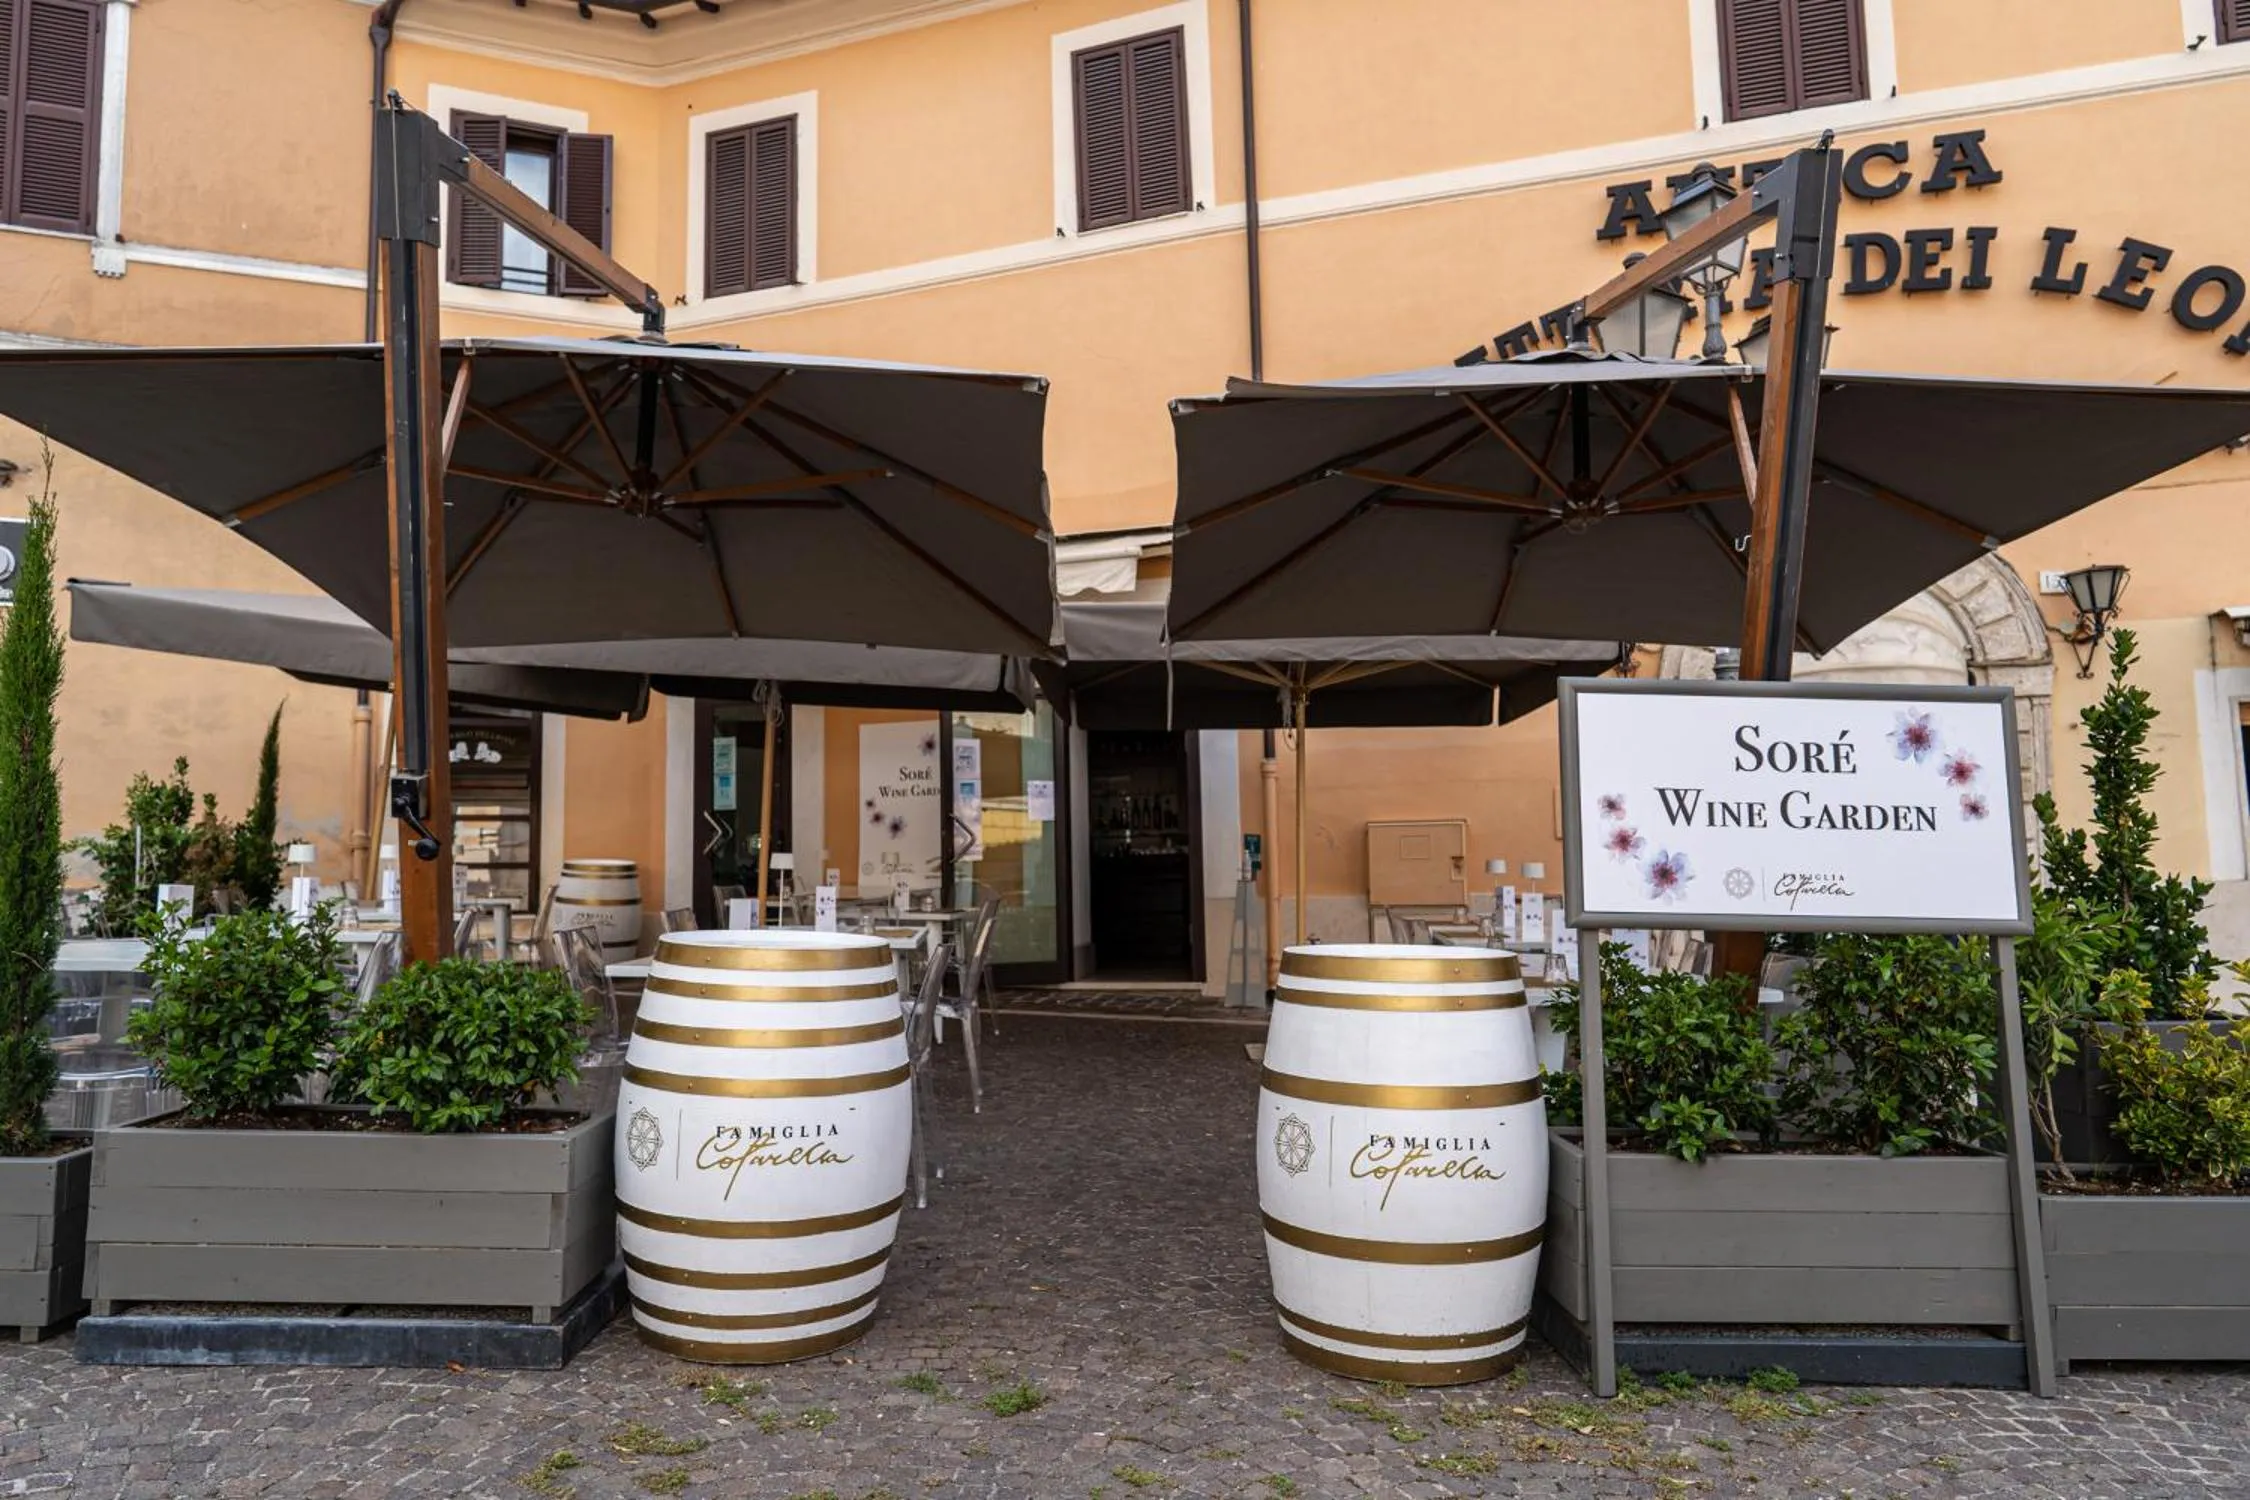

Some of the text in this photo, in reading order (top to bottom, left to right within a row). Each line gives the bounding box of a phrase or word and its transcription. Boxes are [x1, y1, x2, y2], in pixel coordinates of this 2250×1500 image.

[1843, 227, 1998, 295] DEI
[910, 784, 940, 797] GARD
[1654, 787, 1937, 832] WINE GARDEN
[716, 1124, 839, 1139] FAMIGLIA
[1369, 1134, 1492, 1150] FAMIGLIA
